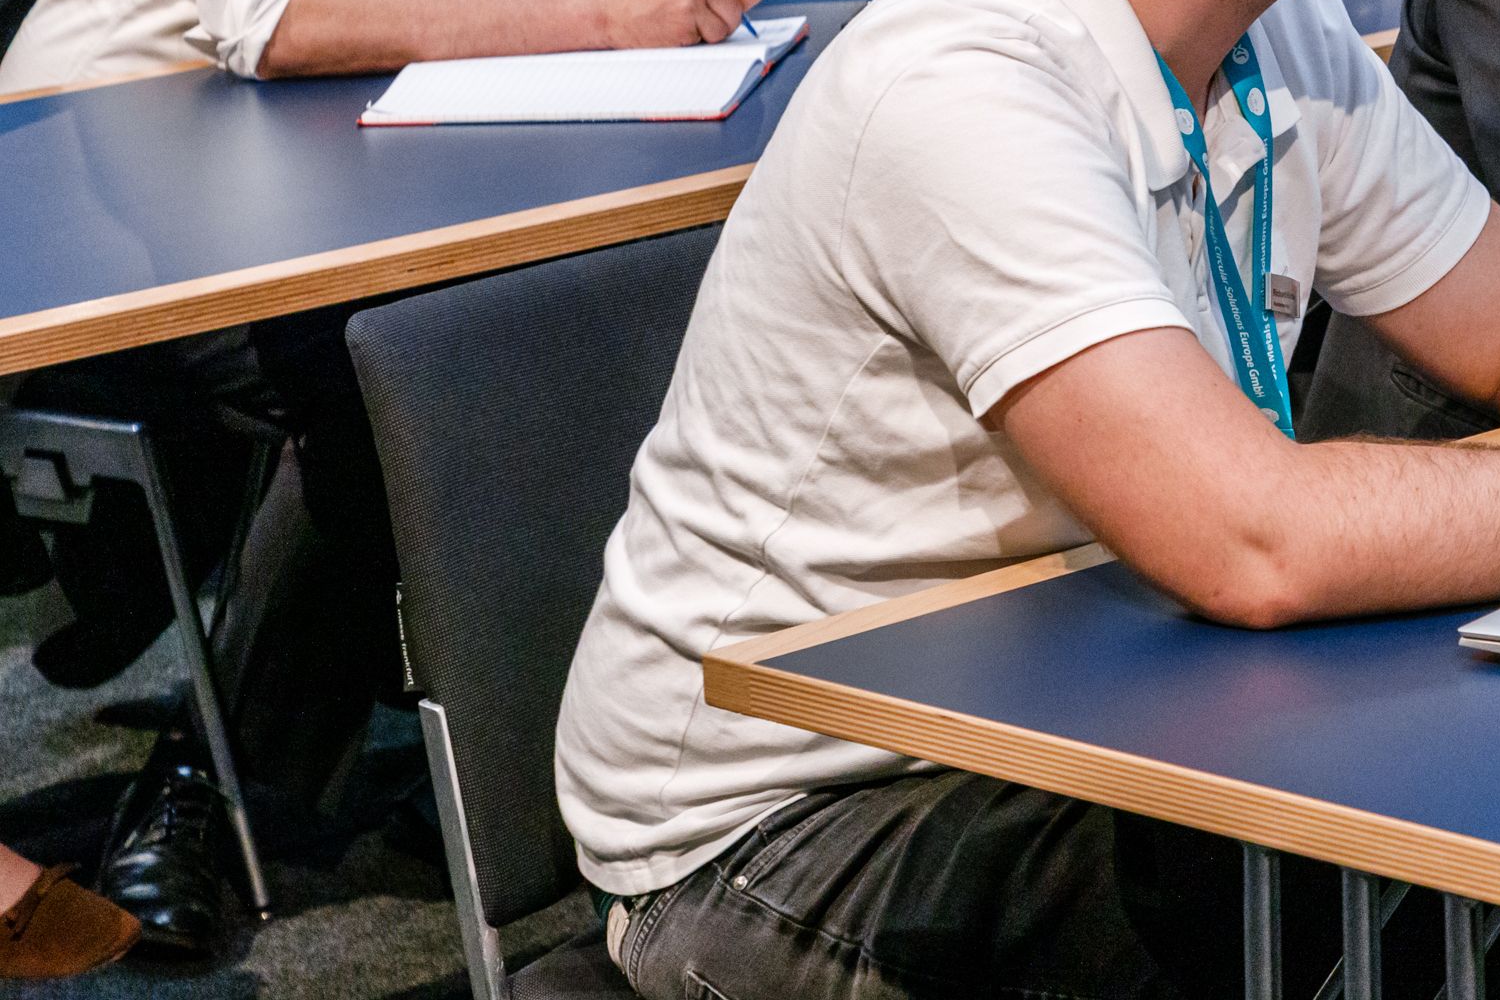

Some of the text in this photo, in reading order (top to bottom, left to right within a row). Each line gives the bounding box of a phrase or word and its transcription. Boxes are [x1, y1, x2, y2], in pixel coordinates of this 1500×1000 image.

[1261, 176, 1269, 220] Europe
[1214, 245, 1229, 288] Circular
[1224, 286, 1245, 331] Solutions
[1239, 331, 1255, 368] Europe
[1248, 369, 1265, 398] GmbH
[1263, 323, 1275, 362] Metals
[401, 643, 414, 686] frankfurt
